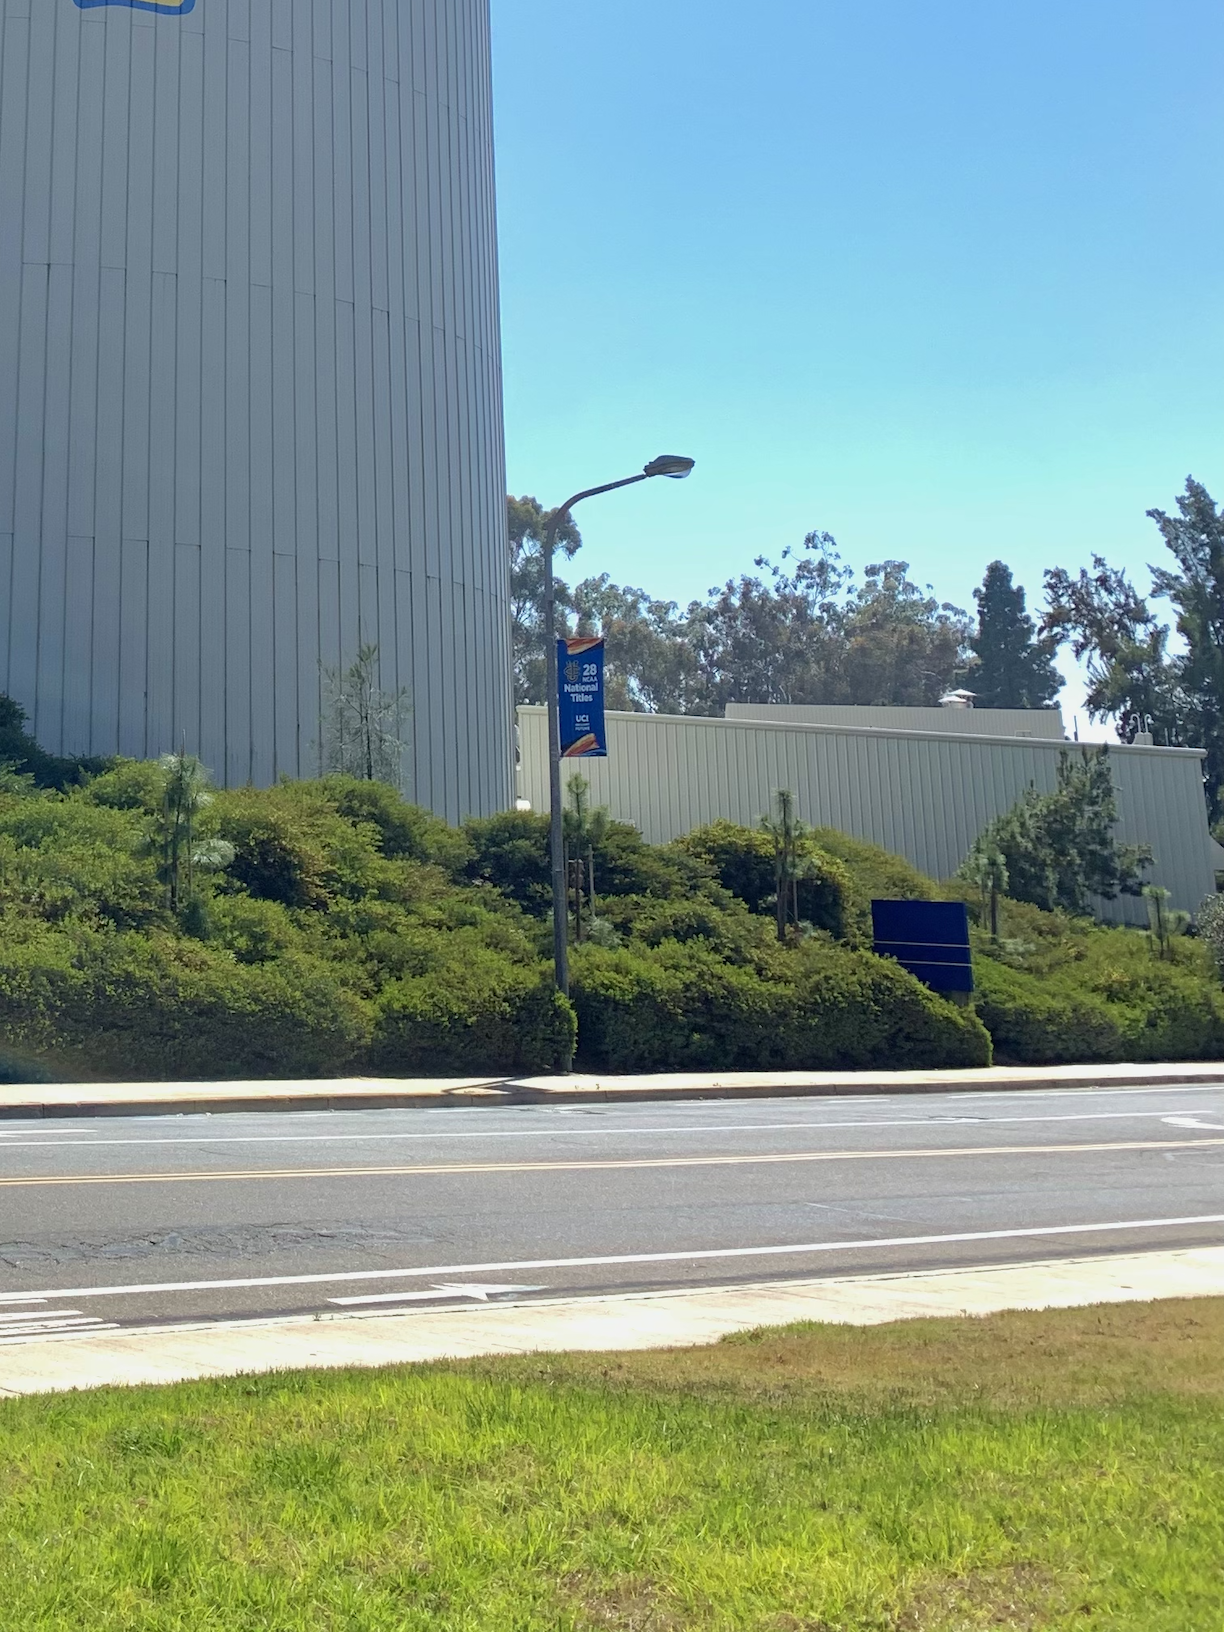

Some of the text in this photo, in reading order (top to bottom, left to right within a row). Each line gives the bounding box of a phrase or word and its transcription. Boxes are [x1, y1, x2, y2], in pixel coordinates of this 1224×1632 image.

[582, 663, 597, 676] 28
[563, 683, 599, 693] National
[570, 693, 593, 702] Titles
[575, 714, 589, 722] UCI
